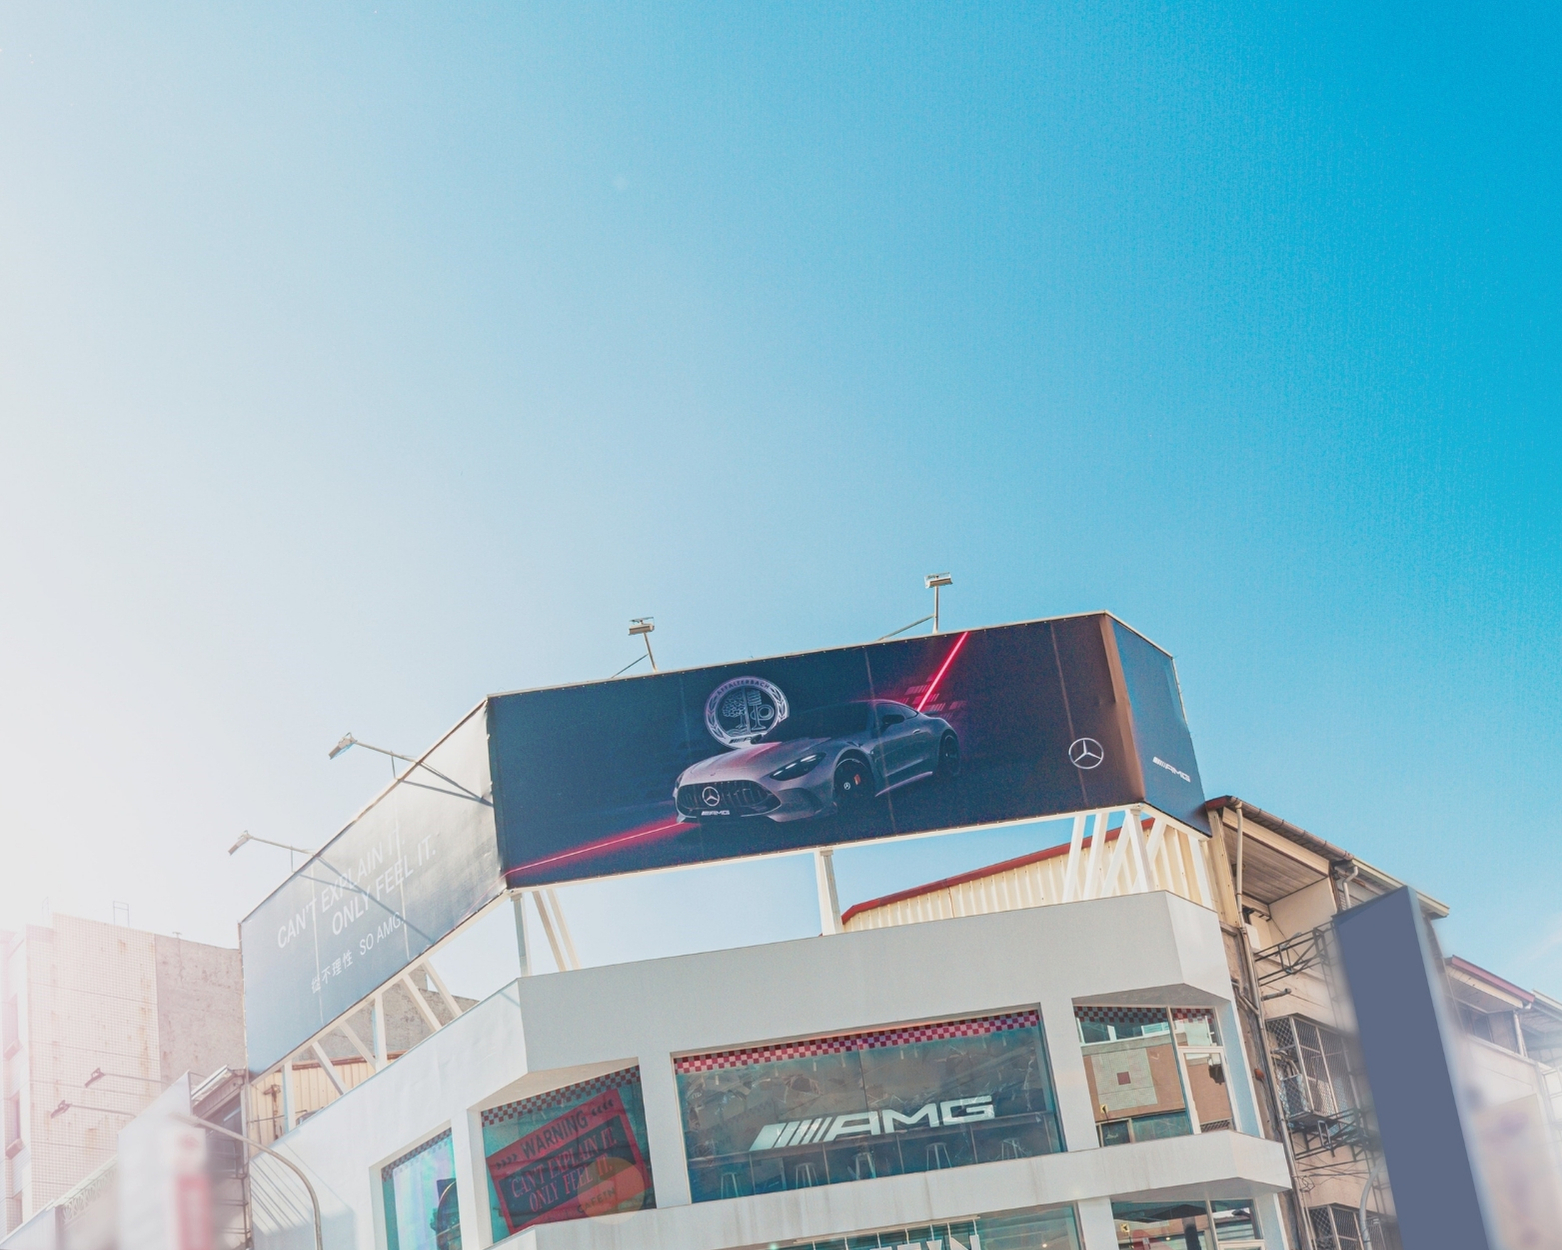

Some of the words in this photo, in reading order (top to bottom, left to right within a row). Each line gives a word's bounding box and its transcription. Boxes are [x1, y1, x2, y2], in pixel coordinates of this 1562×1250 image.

[277, 898, 317, 948] CAN'T
[321, 842, 384, 913] EXPLAIN
[332, 885, 372, 936] ONLY
[375, 855, 414, 901] FEEL
[417, 835, 436, 866] IT.
[359, 933, 374, 956] SO
[520, 1110, 589, 1159] WARNING
[818, 1095, 996, 1142] AMG
[510, 1163, 544, 1199] CAN'T
[548, 1134, 598, 1179] EXPLAIN
[601, 1126, 618, 1151] IT.
[529, 1179, 559, 1213] ONLY
[562, 1165, 594, 1195] FEEL
[596, 1153, 613, 1176] IT.
